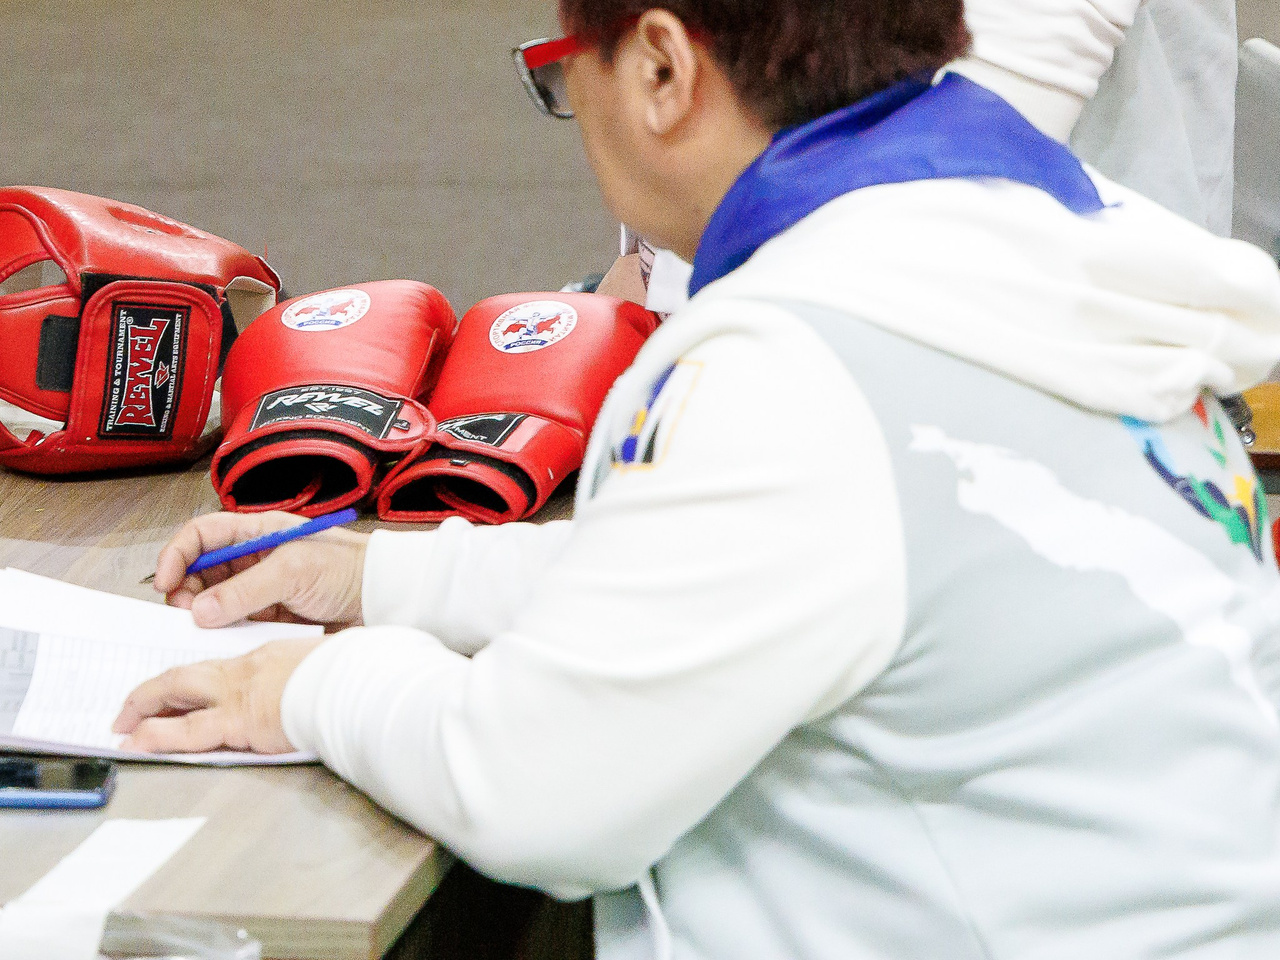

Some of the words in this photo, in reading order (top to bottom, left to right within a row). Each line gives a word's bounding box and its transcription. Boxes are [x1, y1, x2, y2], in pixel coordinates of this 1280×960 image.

[115, 309, 128, 376] TOURNAMENT
[173, 313, 182, 355] EQUIPMENT
[114, 318, 171, 427] REYVEL
[114, 378, 121, 386] &
[171, 355, 179, 373] ARTS
[106, 387, 120, 432] TRAINING
[167, 374, 176, 403] MARTIAL
